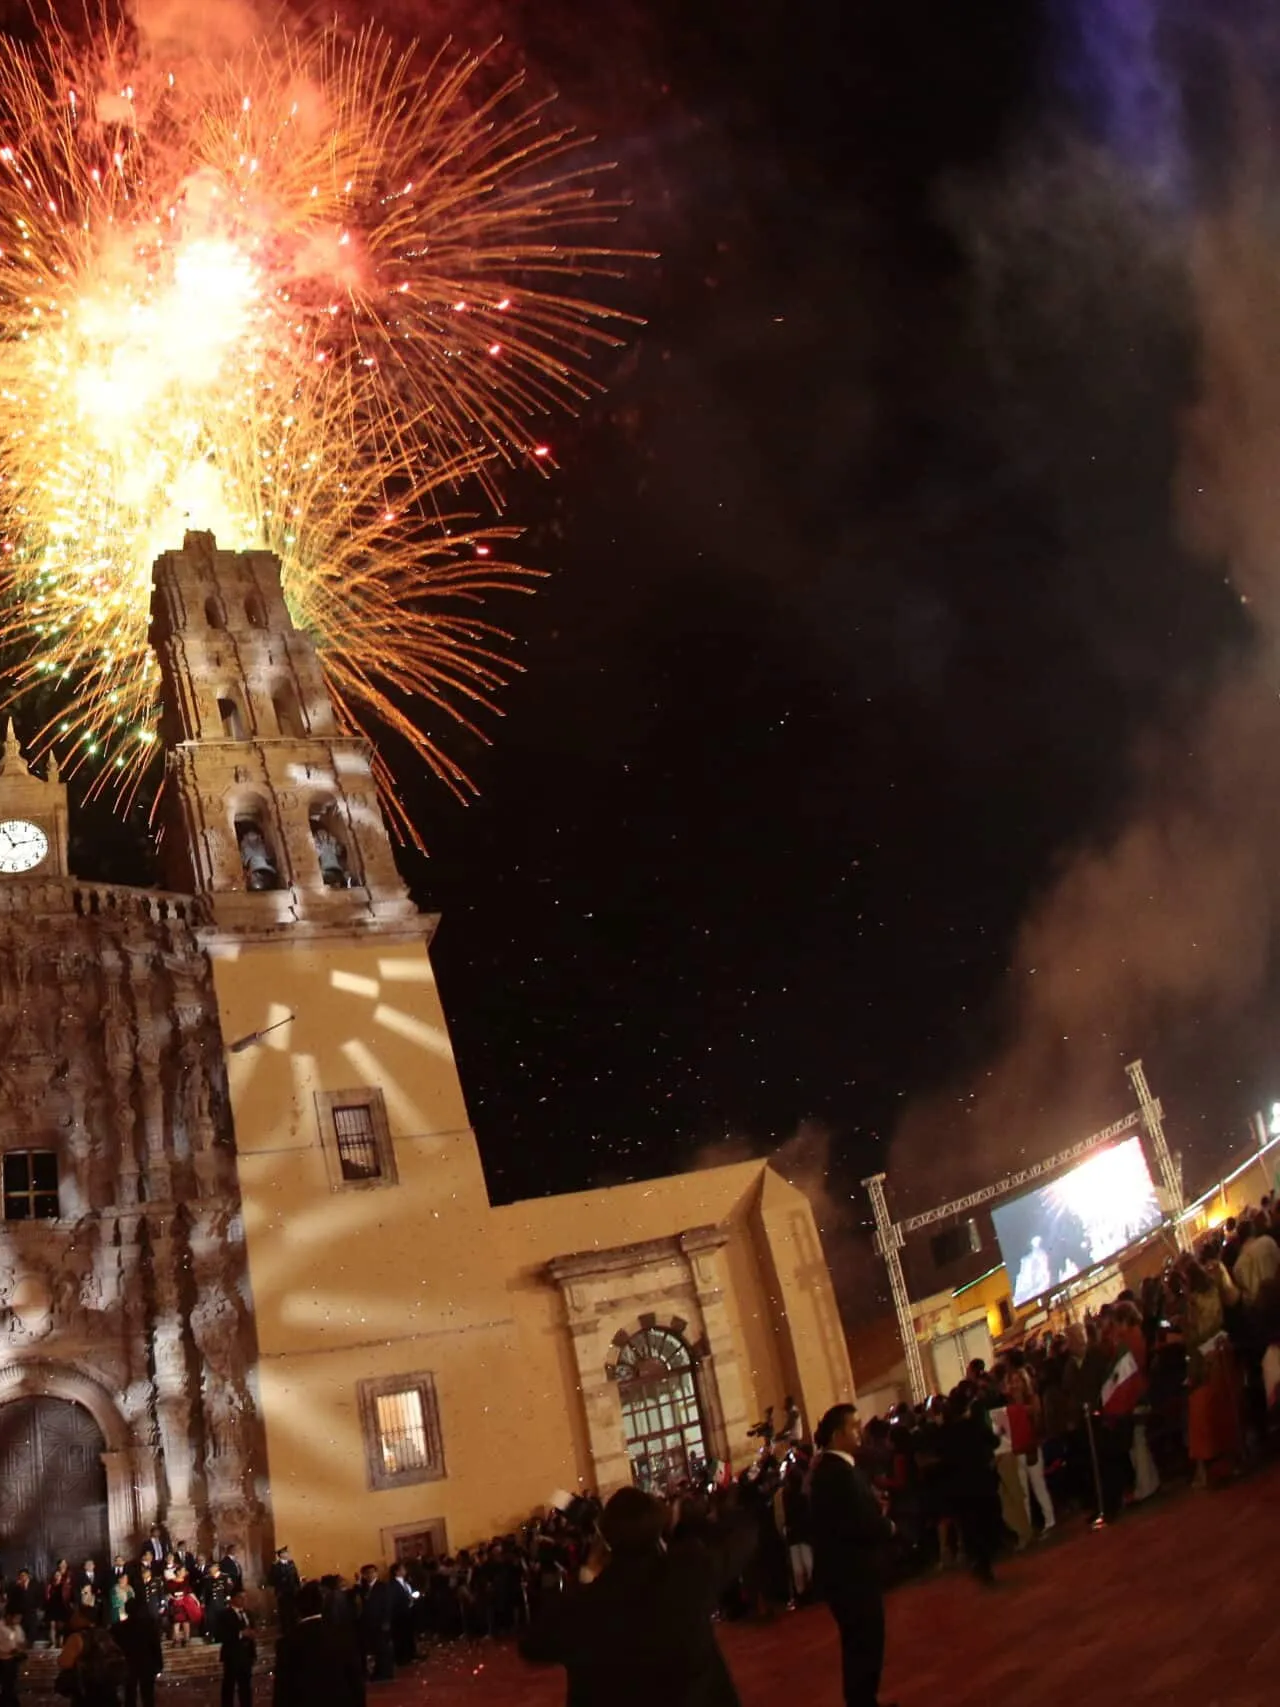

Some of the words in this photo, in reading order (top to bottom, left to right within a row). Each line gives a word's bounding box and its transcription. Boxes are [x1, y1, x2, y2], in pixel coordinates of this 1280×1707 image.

[9, 823, 18, 832] 12
[0, 861, 5, 869] 7
[11, 862, 18, 871] 6
[24, 859, 31, 868] 5
